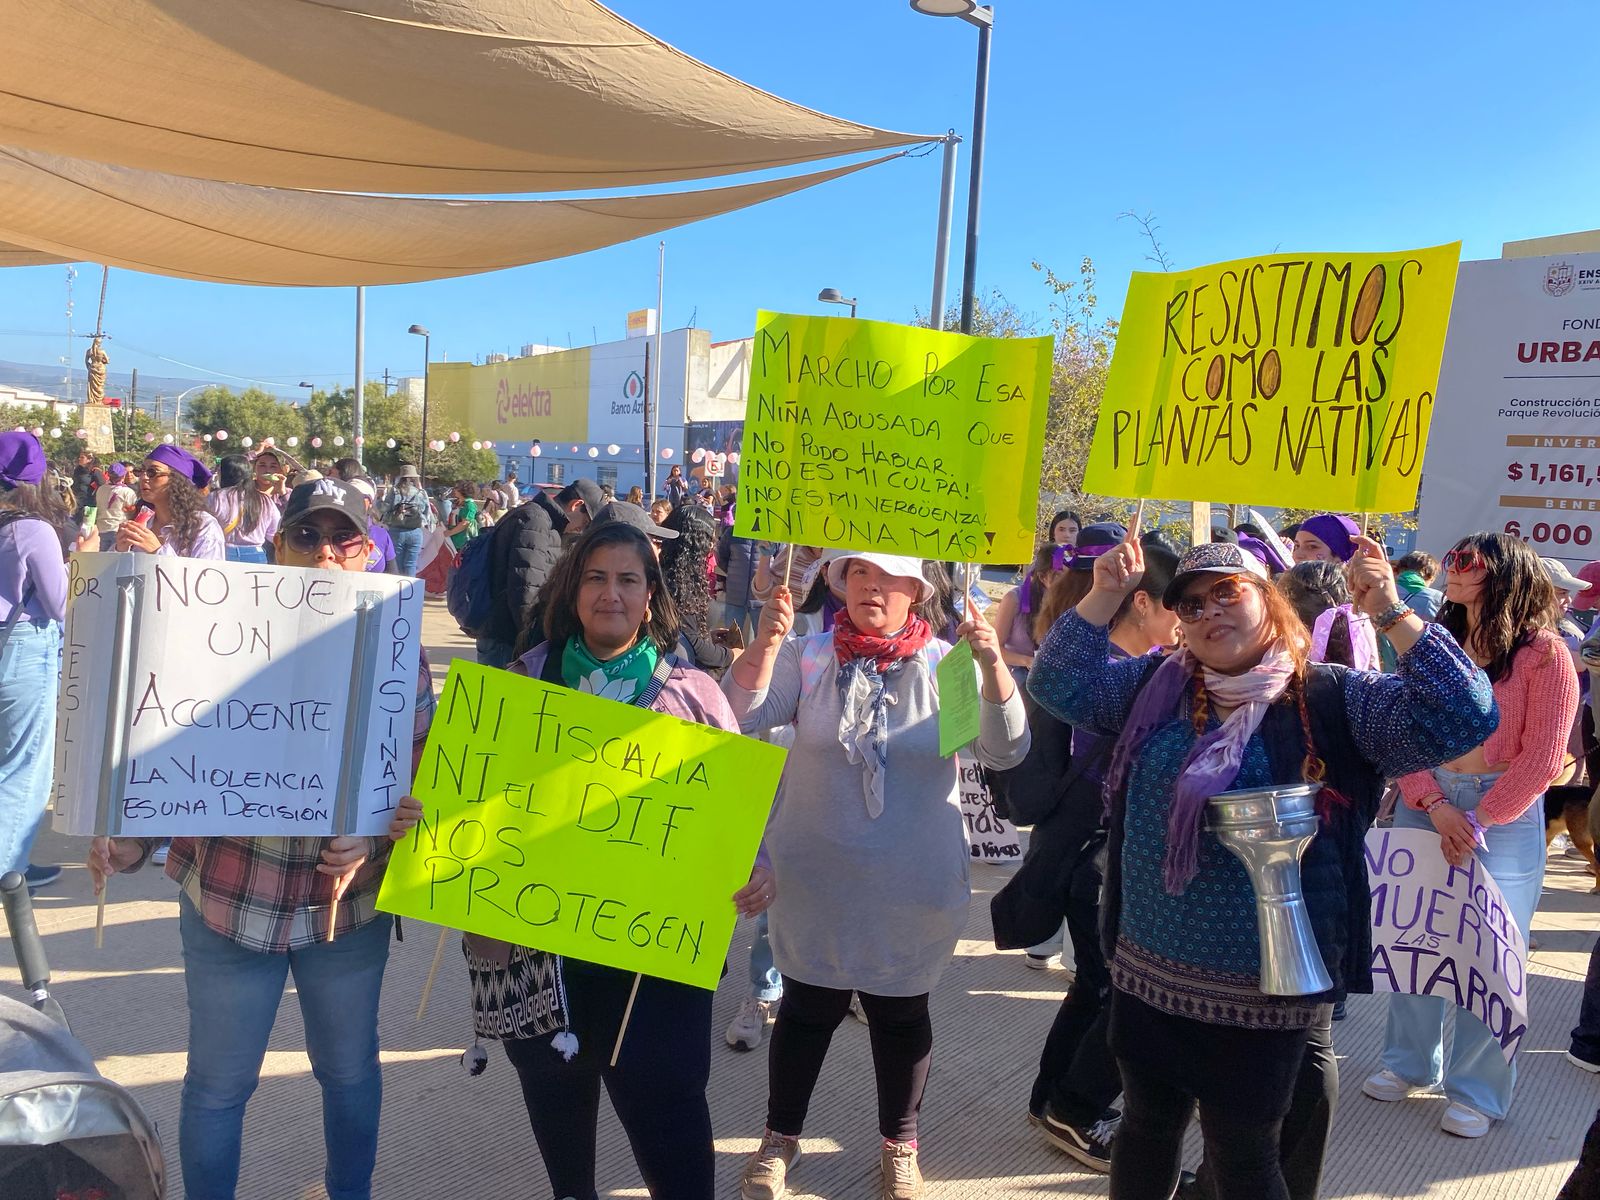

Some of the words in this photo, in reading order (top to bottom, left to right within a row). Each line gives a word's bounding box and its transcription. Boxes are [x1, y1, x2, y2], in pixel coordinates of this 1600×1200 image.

[1163, 259, 1423, 358] RESISTIMOS
[761, 328, 893, 390] MARCHO
[975, 363, 1026, 404] ESA
[1517, 340, 1600, 364] URBA
[1181, 348, 1282, 402] COMO
[1311, 346, 1390, 403] LAS
[511, 384, 553, 417] elektra
[611, 401, 631, 415] Banco
[757, 393, 813, 427] NIÑA
[823, 402, 941, 441] ABUSADA
[967, 421, 1016, 446] QUE
[1498, 408, 1540, 420] Parque
[1542, 408, 1600, 419] Revolució
[1510, 397, 1591, 408] Construcción
[752, 431, 785, 454] NO
[801, 432, 849, 462] PUDO
[1112, 402, 1259, 472] PLANTAS
[1273, 391, 1433, 477] NATIVAS
[1534, 438, 1596, 448] INVER
[312, 479, 347, 506] NY
[746, 459, 792, 481] ¡NO
[800, 462, 834, 481] ES
[845, 465, 878, 488] MI
[887, 472, 969, 500] CULPA!
[745, 484, 782, 504] ¡NO
[790, 489, 825, 508] ES
[828, 491, 858, 508] MI
[865, 497, 988, 527] VERGÜENZA!
[1545, 499, 1597, 511] BENE
[750, 507, 803, 536] ¡NI
[823, 516, 900, 547] UNA
[1504, 520, 1593, 546] 6,000
[69, 559, 102, 601] POR
[155, 564, 230, 612] NO
[244, 571, 335, 615] FUE
[207, 619, 272, 661] UN
[132, 672, 333, 732] ACCIDENTE
[446, 672, 505, 742] NI
[532, 689, 711, 791] FISCALIA
[129, 758, 168, 785] LA
[170, 755, 324, 791] VIOLENCIA
[431, 742, 498, 804] NI
[502, 782, 547, 817] EL
[221, 790, 329, 822] DECISIÓN
[412, 808, 526, 868] NOS
[423, 855, 706, 965] PROTEGEN
[1394, 930, 1442, 949] LAS
[1369, 944, 1527, 1067] ATARON
